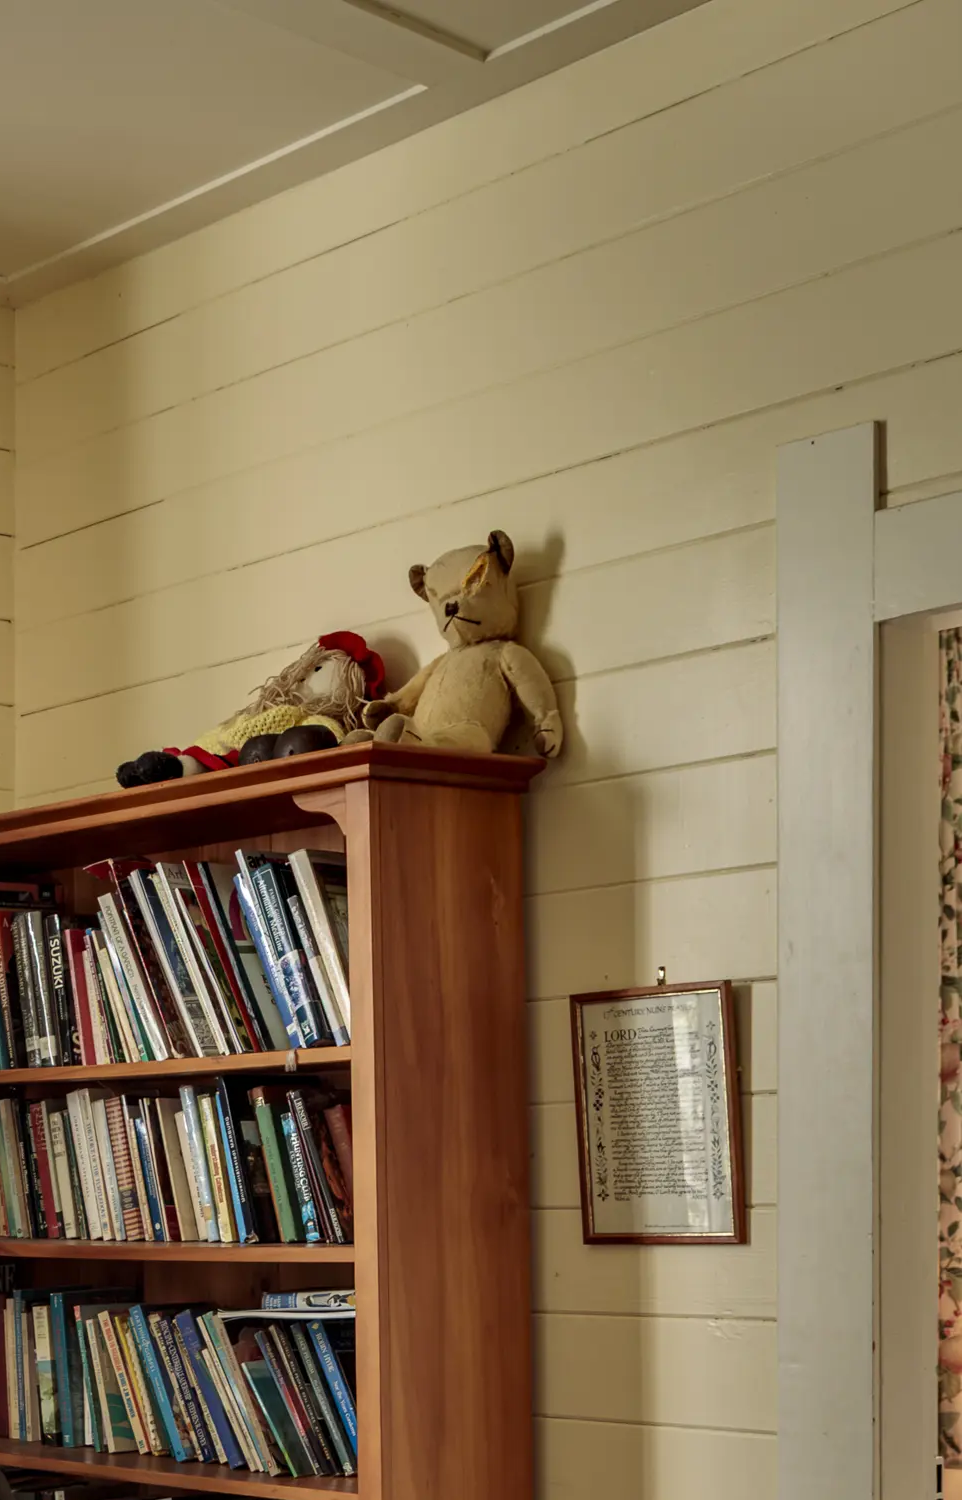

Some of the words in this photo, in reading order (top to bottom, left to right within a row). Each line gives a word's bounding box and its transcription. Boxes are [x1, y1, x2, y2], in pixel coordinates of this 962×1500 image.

[167, 868, 183, 879] Art
[268, 888, 277, 907] FAMILY
[257, 878, 275, 918] Alternative
[269, 918, 285, 952] Medicine
[103, 904, 119, 935] PORTRAIT
[114, 935, 122, 945] OF
[120, 950, 134, 978] GARDEN
[49, 938, 64, 989] SUZUKI
[613, 1008, 644, 1018] CENTURY
[604, 1029, 637, 1043] LORD
[294, 1100, 310, 1128] RENOIR
[223, 1115, 235, 1148] MARBURG
[208, 1143, 221, 1176] Understanding
[288, 1134, 308, 1177] HUNTING
[298, 1177, 314, 1202] CLUB
[157, 1319, 184, 1372] PRINCIPLE-CENTERED
[175, 1369, 193, 1401] LEADERSHIP
[301, 1351, 315, 1374] PILGRIM
[314, 1332, 328, 1353] ROBIN
[322, 1353, 335, 1372] HYDE
[186, 1401, 199, 1423] STEPHEN
[195, 1428, 207, 1446] COVEY
